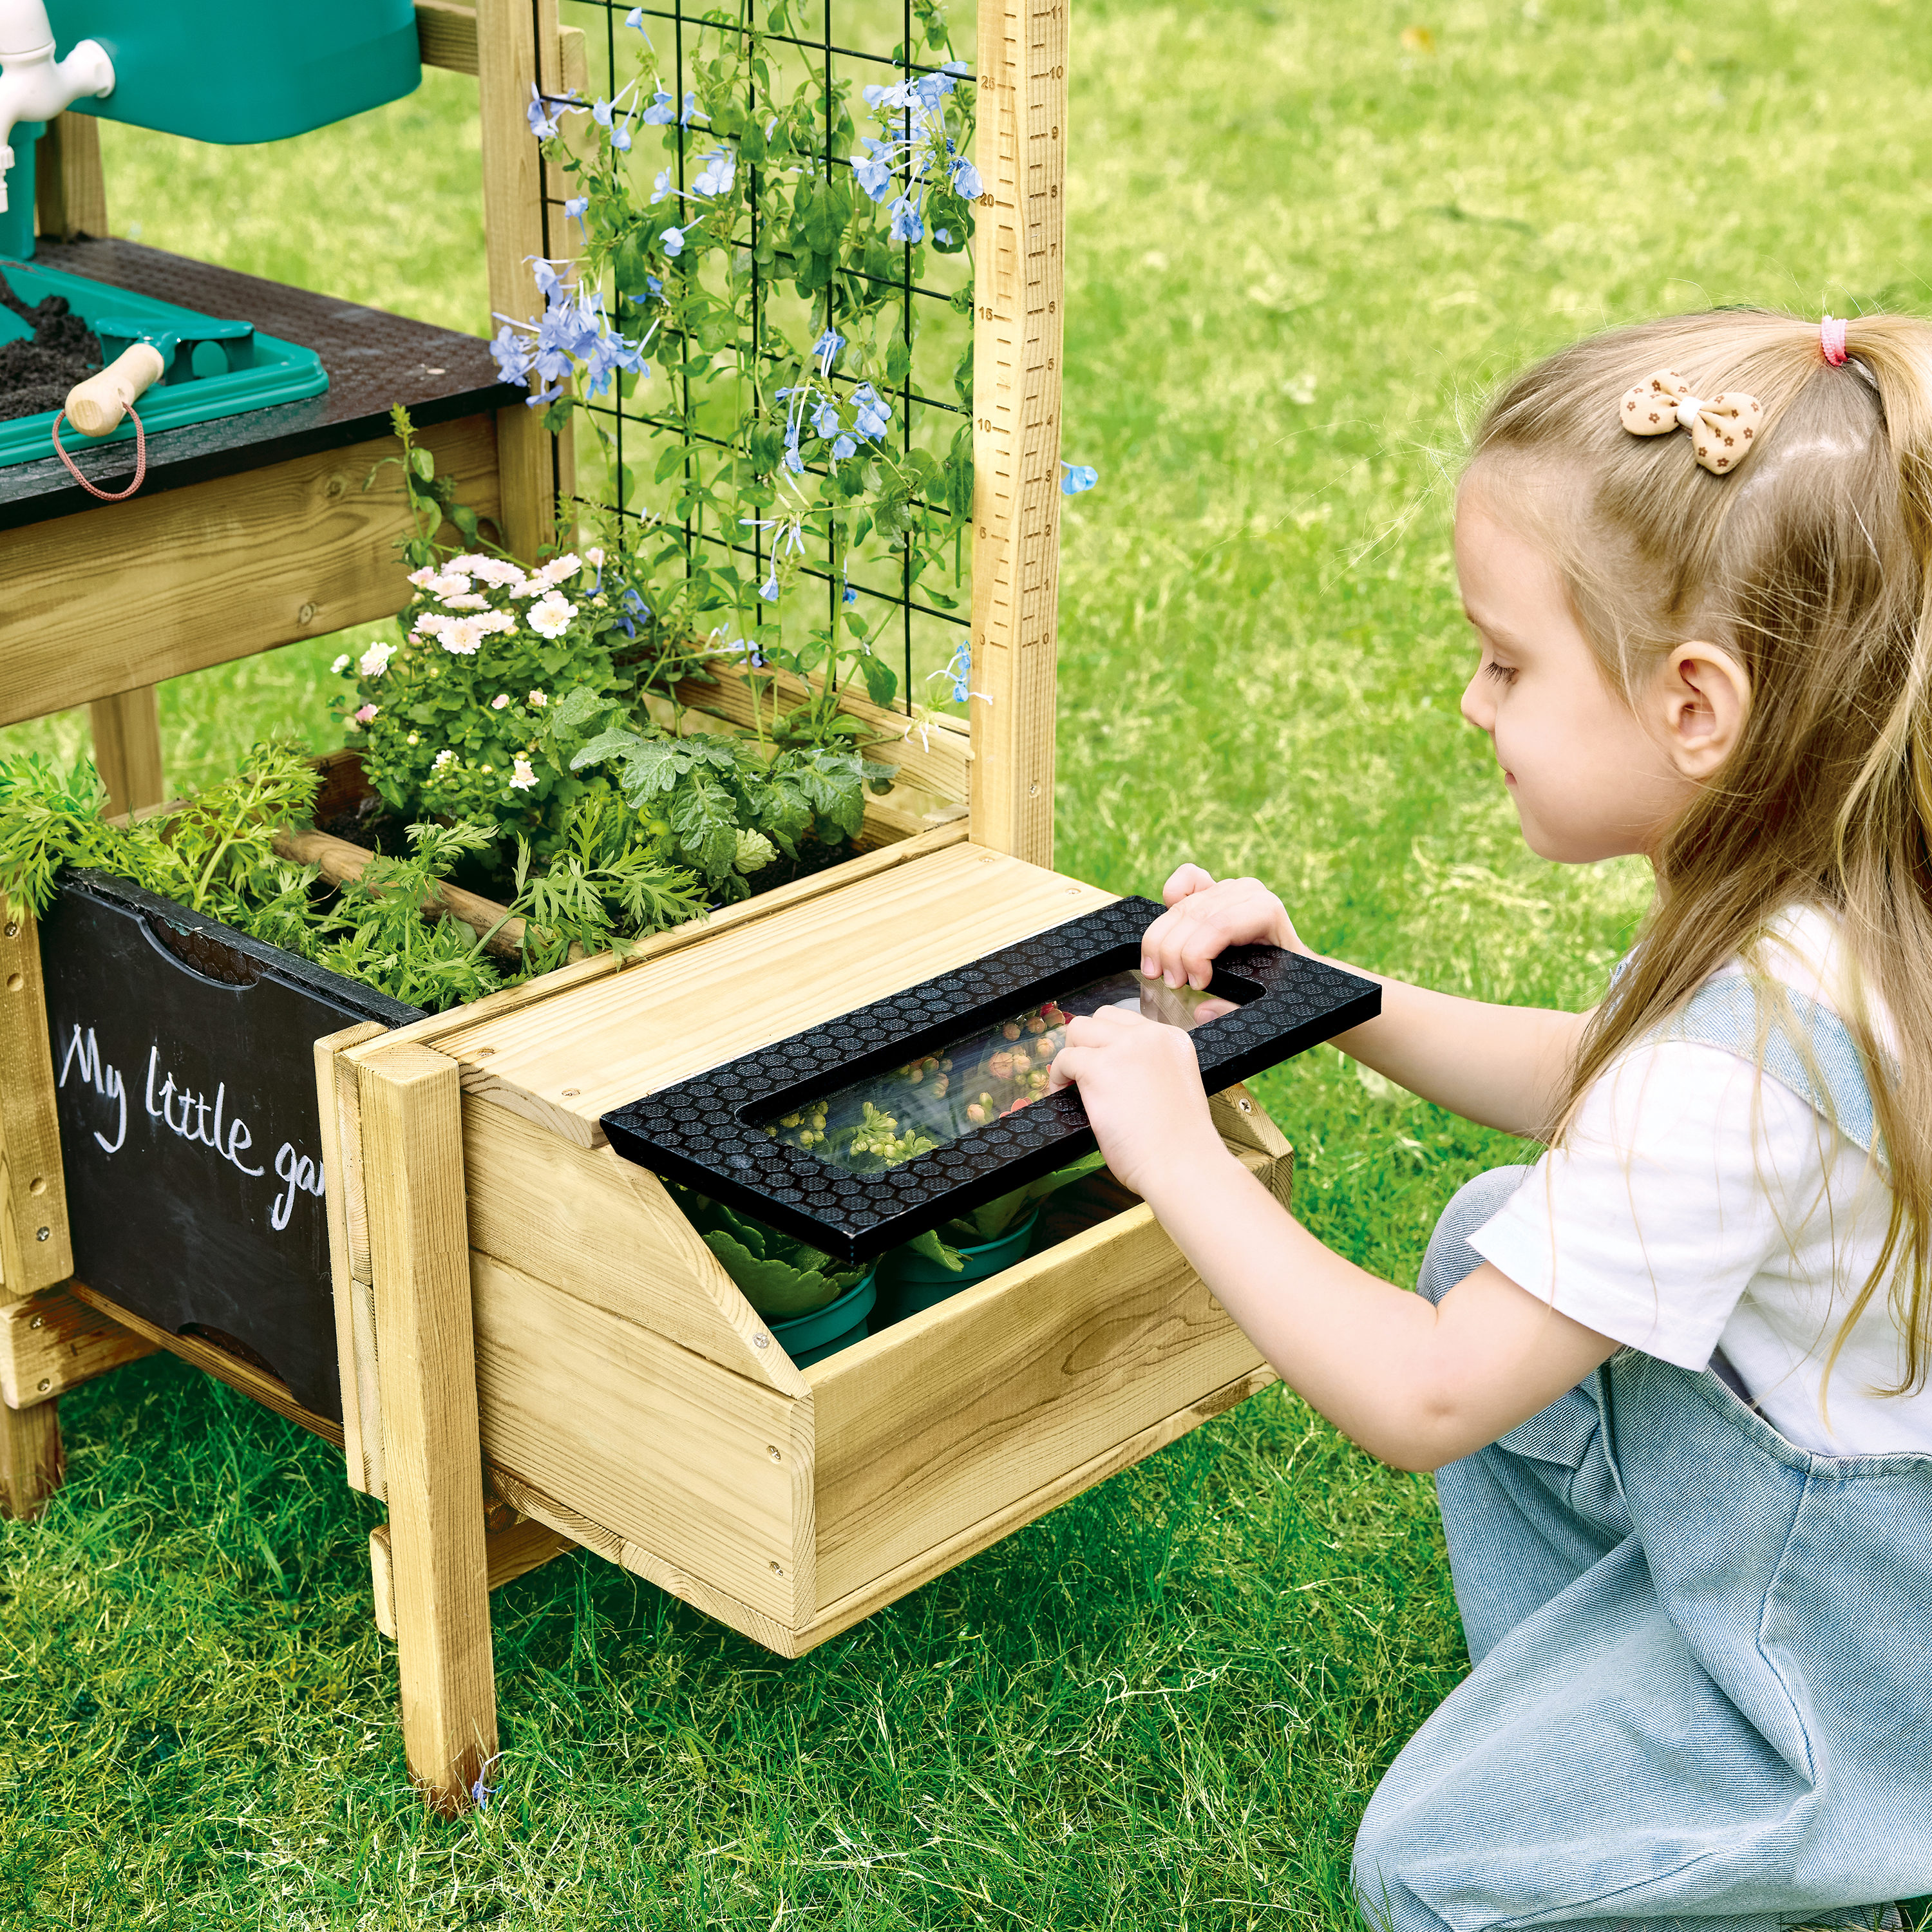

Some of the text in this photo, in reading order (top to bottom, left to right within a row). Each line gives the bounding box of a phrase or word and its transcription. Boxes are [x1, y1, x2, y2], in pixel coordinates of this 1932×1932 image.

[1050, 65, 1063, 80] 10
[981, 75, 996, 91] 25
[1052, 126, 1059, 140] 9
[1051, 185, 1058, 198] 8
[980, 193, 994, 208] 20
[1050, 243, 1057, 258] 7
[1049, 301, 1056, 314] 6
[979, 307, 993, 322] 15
[1048, 357, 1054, 370] 5
[978, 418, 992, 433] 10
[1046, 414, 1054, 427] 4
[1045, 469, 1052, 482] 3
[980, 526, 987, 539] 5
[1045, 524, 1051, 537] 2
[1044, 578, 1049, 591] 1
[1043, 632, 1049, 645] 0
[59, 1023, 127, 1153] My
[146, 1045, 265, 1177] little
